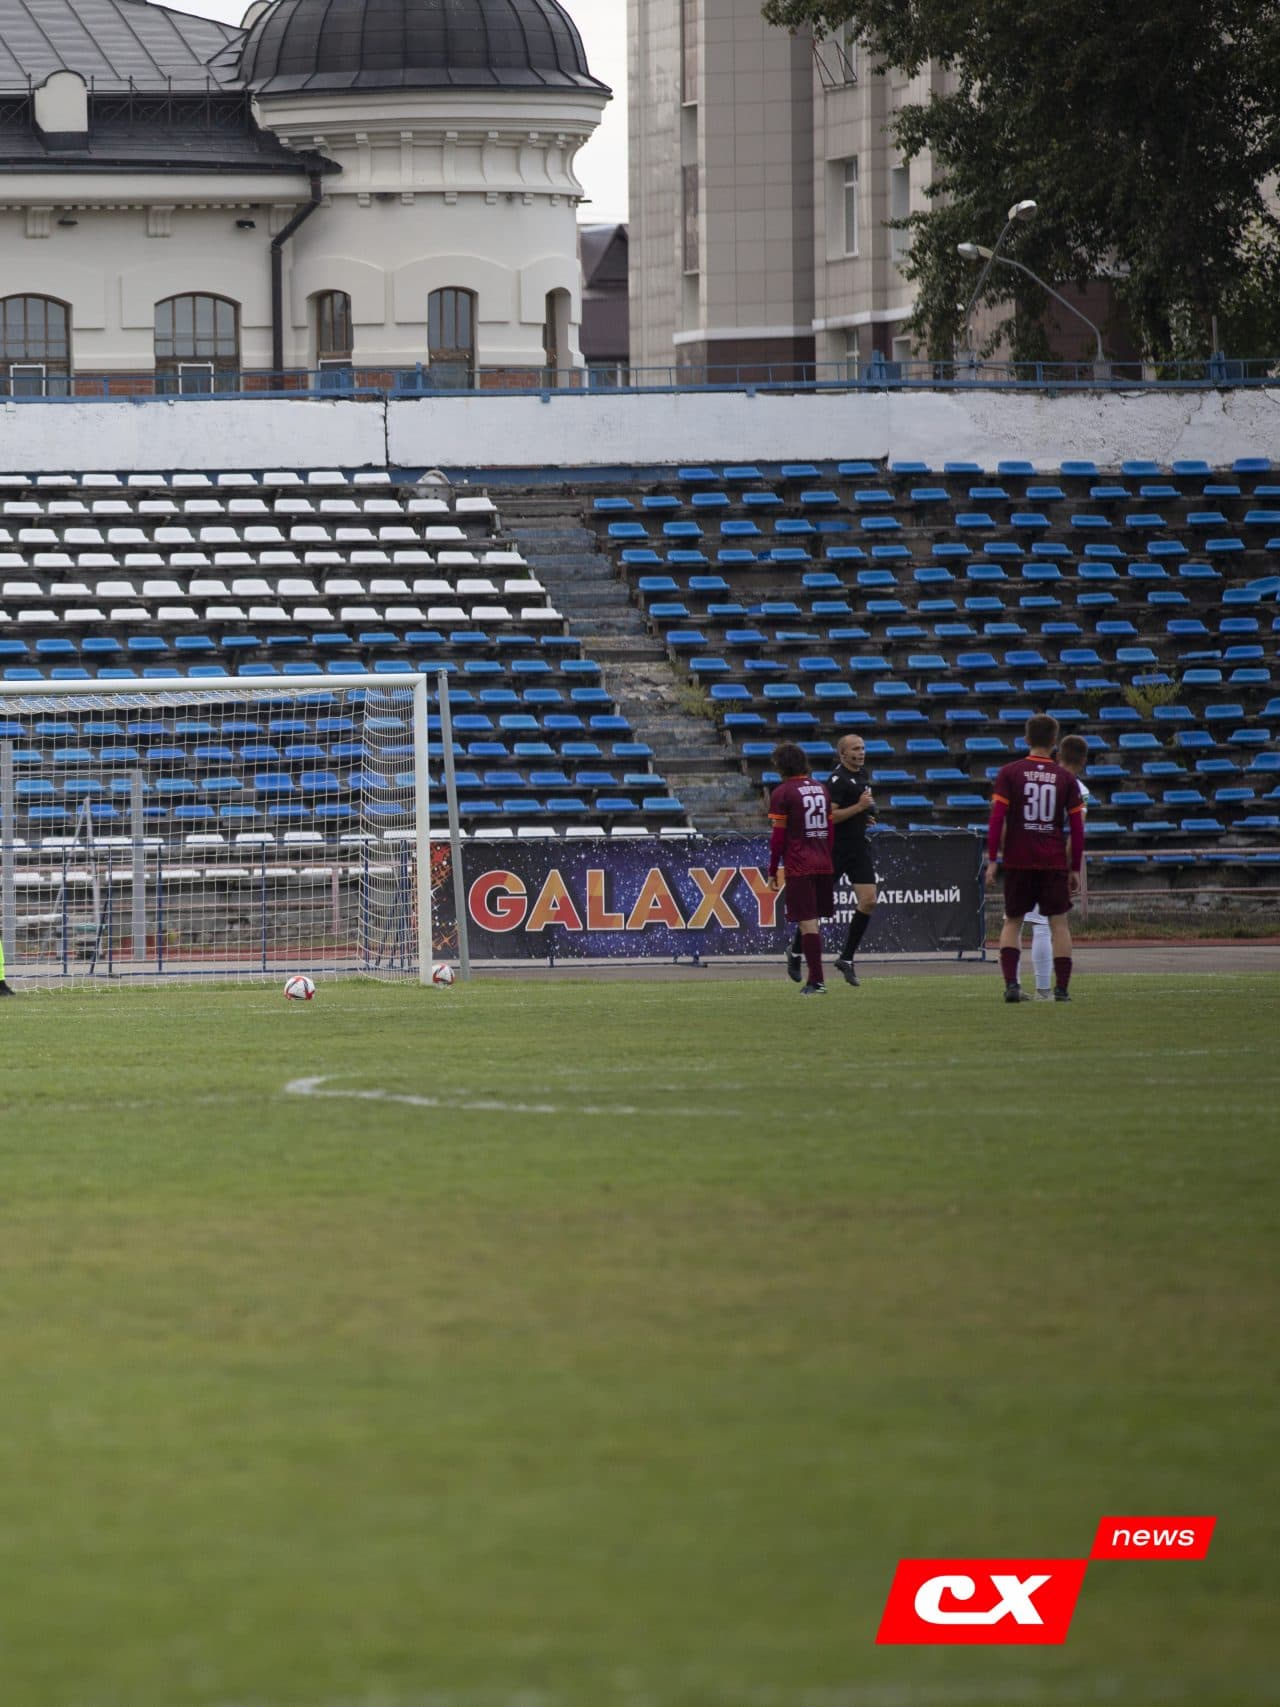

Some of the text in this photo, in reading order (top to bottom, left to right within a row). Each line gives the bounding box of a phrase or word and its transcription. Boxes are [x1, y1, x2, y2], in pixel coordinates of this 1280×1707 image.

[802, 795, 828, 829] 23
[1023, 782, 1057, 822] 30
[468, 867, 786, 933] GALAXY
